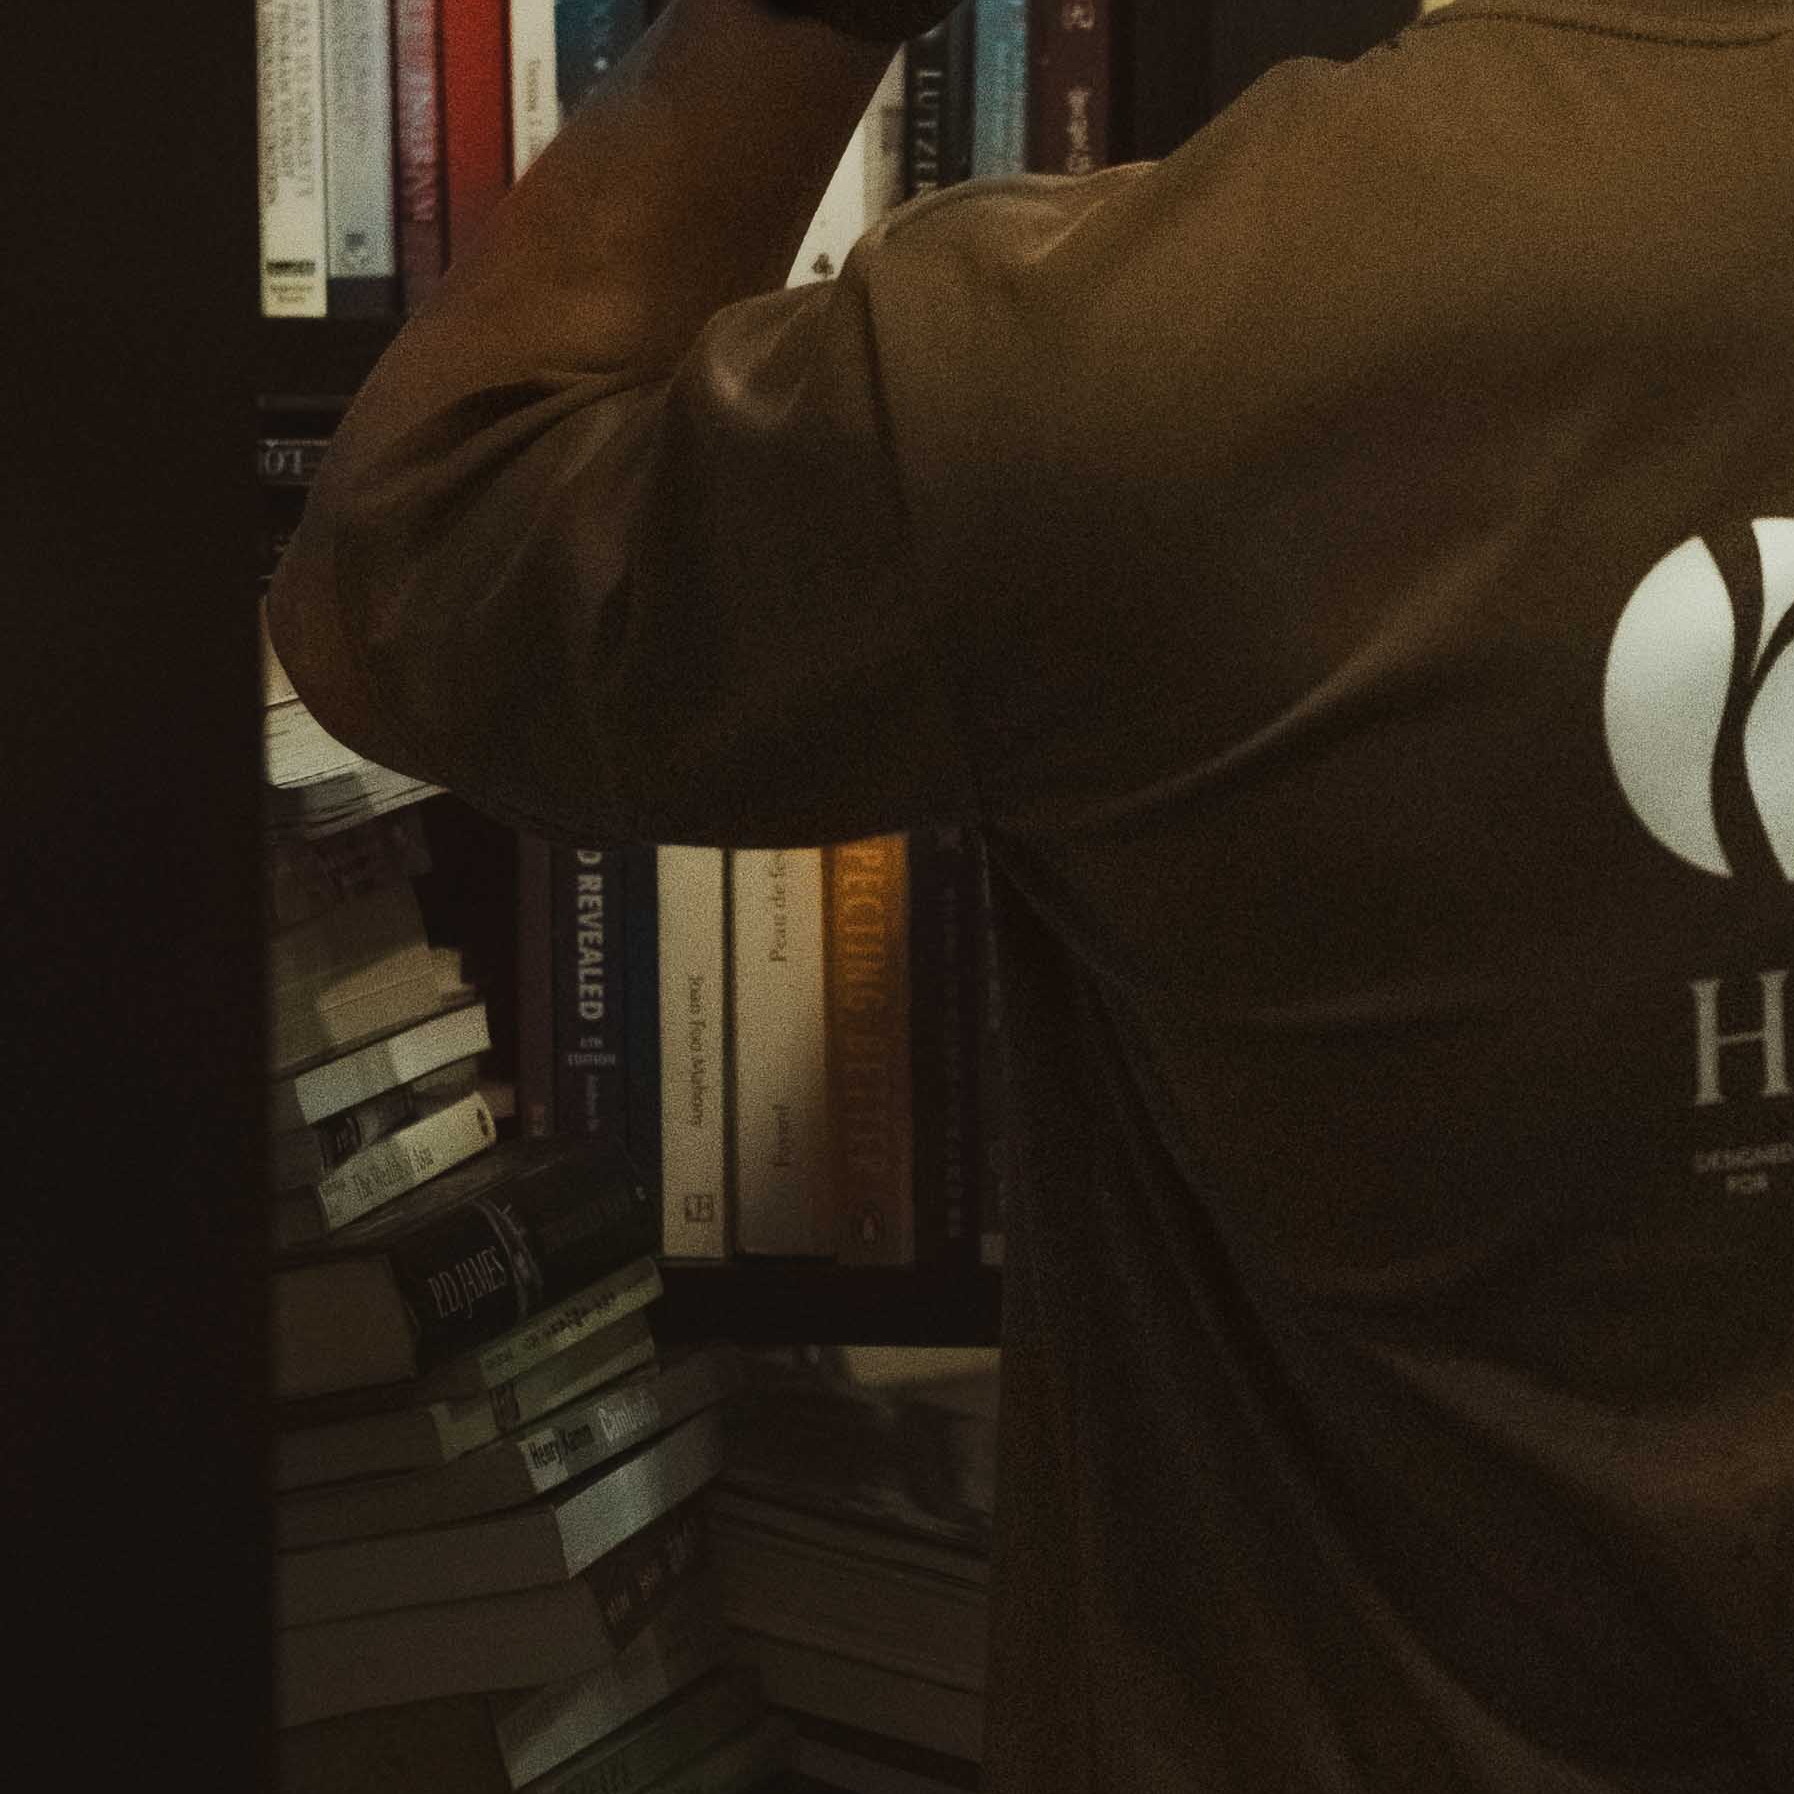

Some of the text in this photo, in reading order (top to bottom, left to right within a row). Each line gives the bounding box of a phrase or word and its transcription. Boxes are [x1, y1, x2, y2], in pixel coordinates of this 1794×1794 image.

[574, 871, 606, 1023] REVEALED
[767, 884, 788, 909] de
[767, 912, 789, 963] Peau
[843, 847, 882, 1012] PECTING
